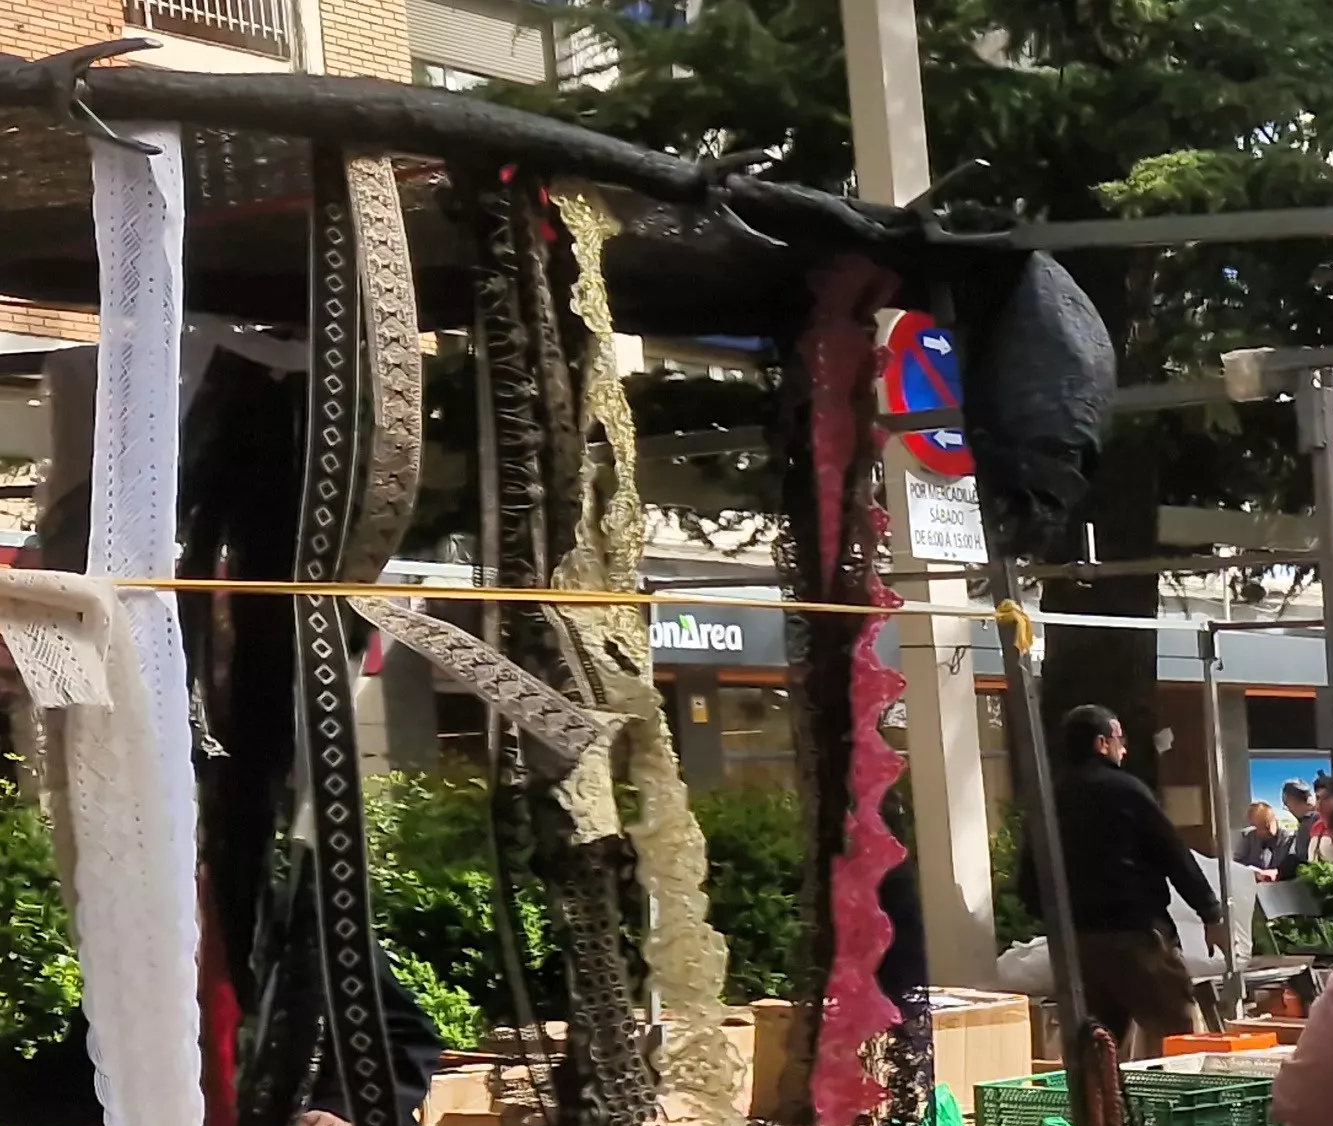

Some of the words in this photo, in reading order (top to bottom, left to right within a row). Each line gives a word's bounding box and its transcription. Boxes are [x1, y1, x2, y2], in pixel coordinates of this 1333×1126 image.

[909, 482, 927, 499] POR
[914, 529, 926, 546] DE
[945, 531, 952, 548] A
[648, 614, 742, 650] onArea
